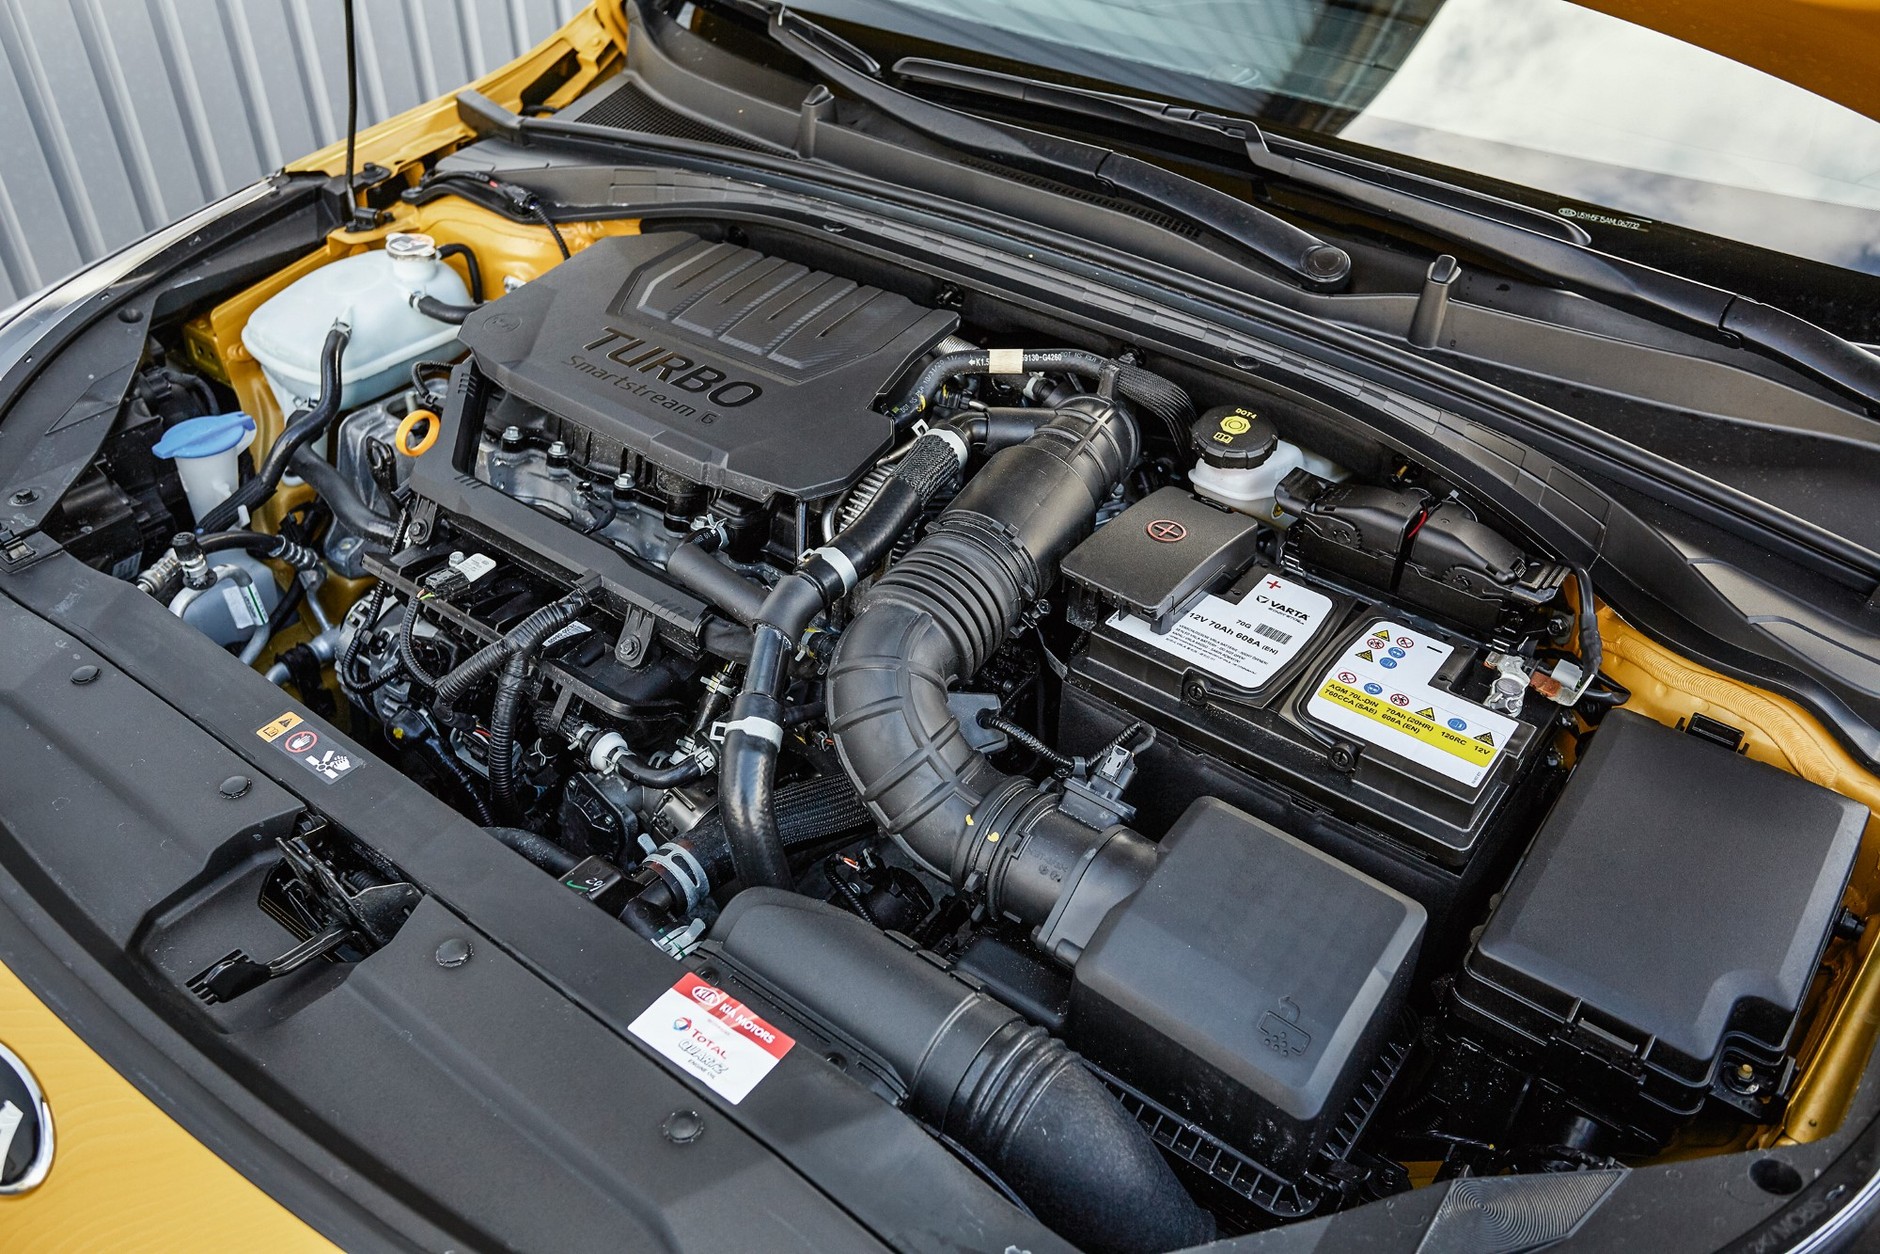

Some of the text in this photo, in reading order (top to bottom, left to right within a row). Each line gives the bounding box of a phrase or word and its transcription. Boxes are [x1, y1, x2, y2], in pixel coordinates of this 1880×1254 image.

[562, 355, 696, 417] Smartstream
[583, 326, 763, 407] TURBO
[1235, 408, 1258, 420] DOT4
[1236, 619, 1252, 629] 70G
[1270, 600, 1309, 621] VARTA
[1189, 612, 1279, 656] 12V 70Ah 608A (EN)
[1324, 689, 1354, 707] 760CCA
[1382, 713, 1402, 727] 608A
[1402, 721, 1420, 734] (EN)
[1328, 683, 1491, 756] AGM 70L-DIN 70Ah (20HR) 120RC 12V
[692, 986, 720, 1006] KIA
[719, 1003, 737, 1018] KIA
[736, 1014, 776, 1045] MOTORS
